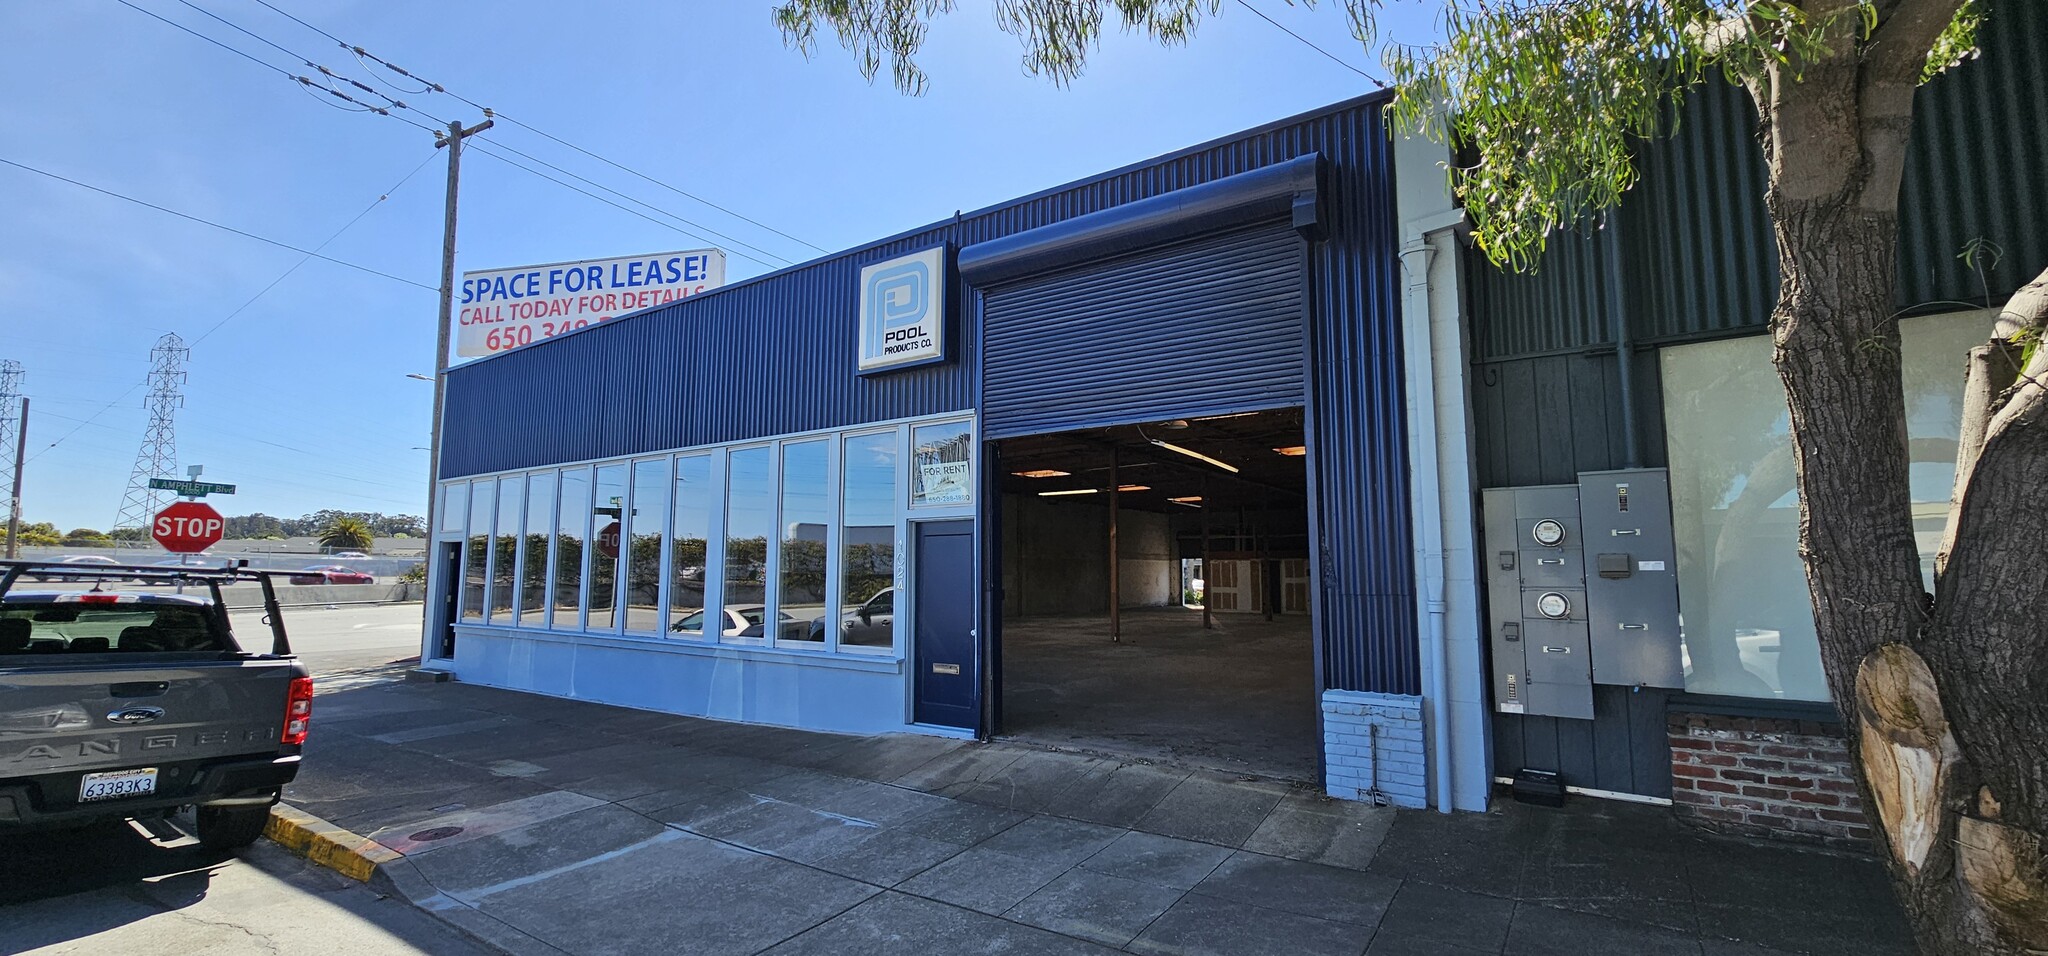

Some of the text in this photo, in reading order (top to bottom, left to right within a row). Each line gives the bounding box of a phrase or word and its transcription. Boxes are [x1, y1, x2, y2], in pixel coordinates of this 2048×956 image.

[461, 255, 708, 304] SPACE FOR LEASE!
[460, 307, 505, 326] CALL
[509, 298, 572, 321] TODAY
[578, 293, 617, 314] FOR
[486, 326, 532, 351] 650
[885, 326, 927, 344] POOL
[884, 340, 919, 356] PRODUCTS
[924, 464, 966, 476] FOR RENT
[150, 480, 235, 494] N AMPHLETT Blvd
[155, 516, 221, 538] STOP
[896, 539, 905, 591] 1024
[10, 727, 274, 762] ANGER
[86, 778, 152, 797] 63383K3
